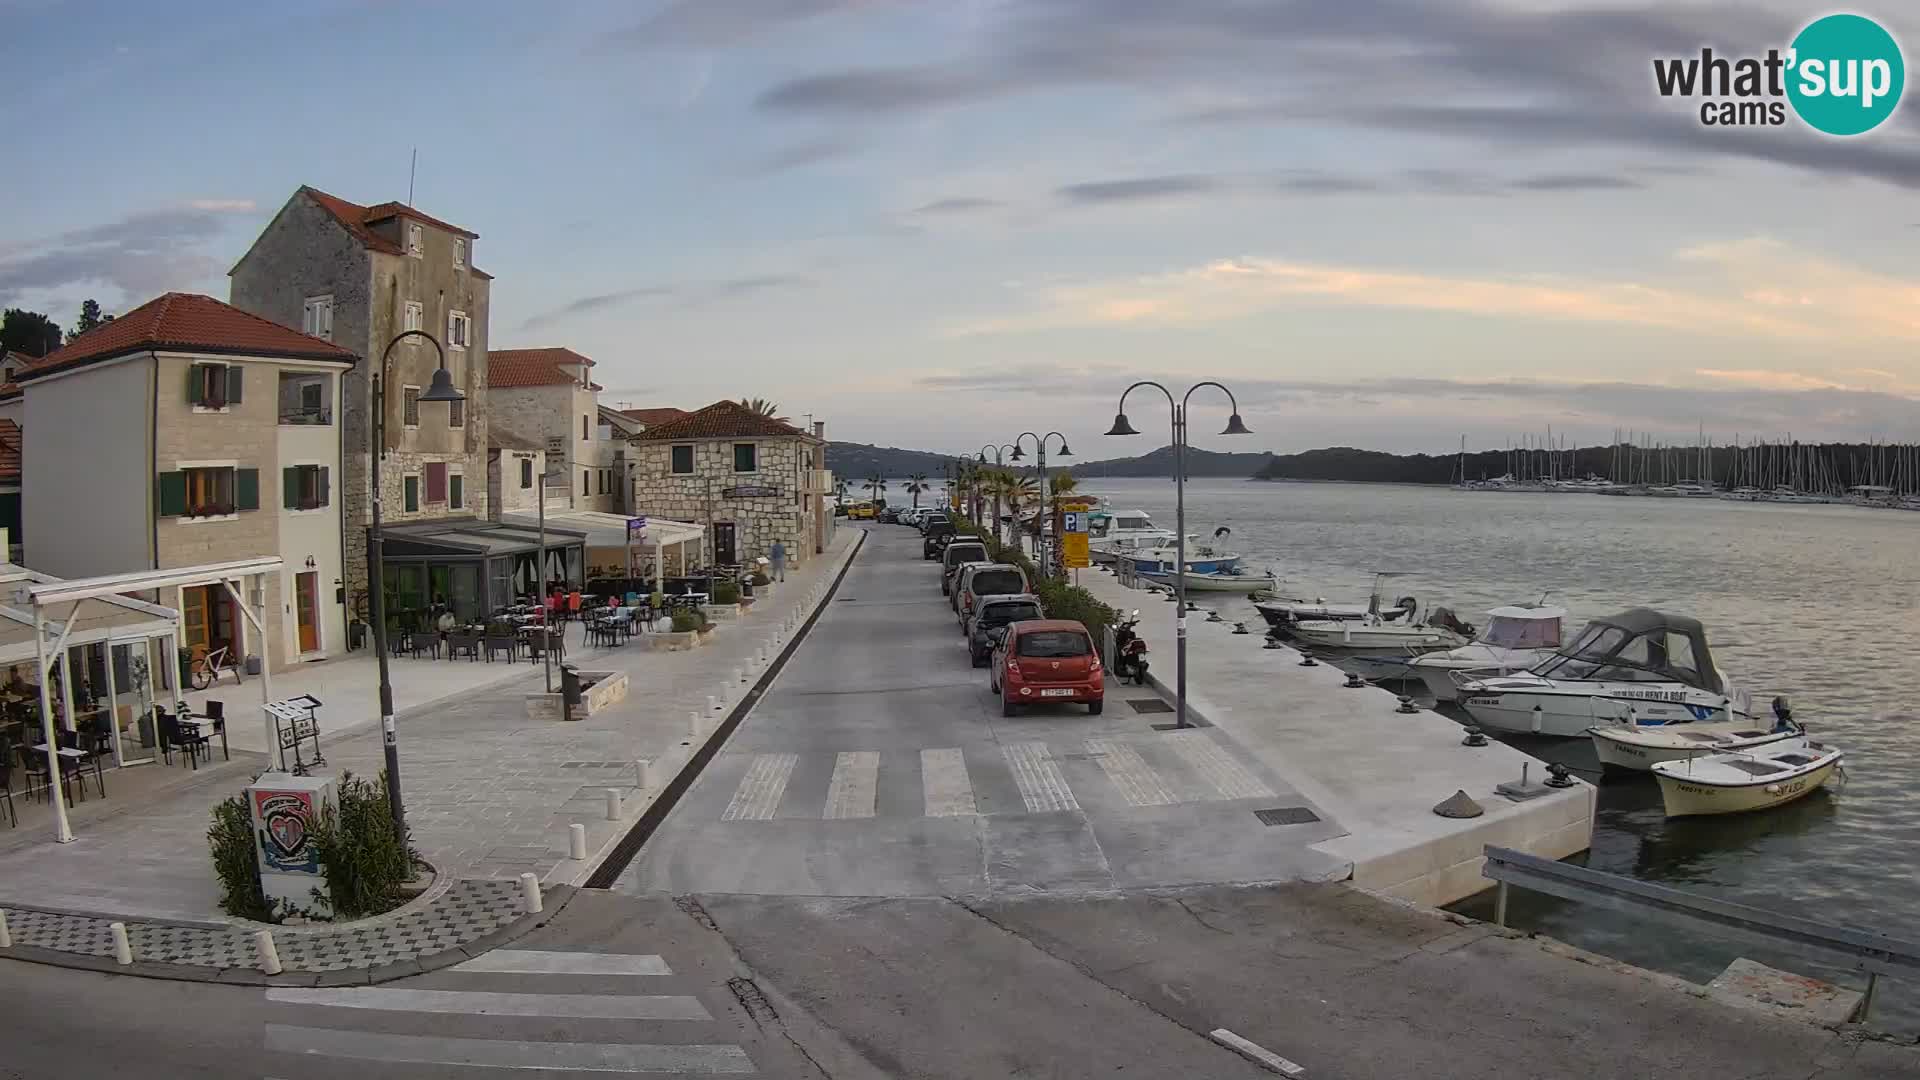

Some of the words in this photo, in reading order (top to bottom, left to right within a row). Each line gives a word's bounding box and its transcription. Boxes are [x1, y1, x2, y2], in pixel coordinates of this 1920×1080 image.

[1065, 514, 1076, 530] P
[1645, 690, 1663, 700] RENT
[1670, 691, 1688, 702] BOAT
